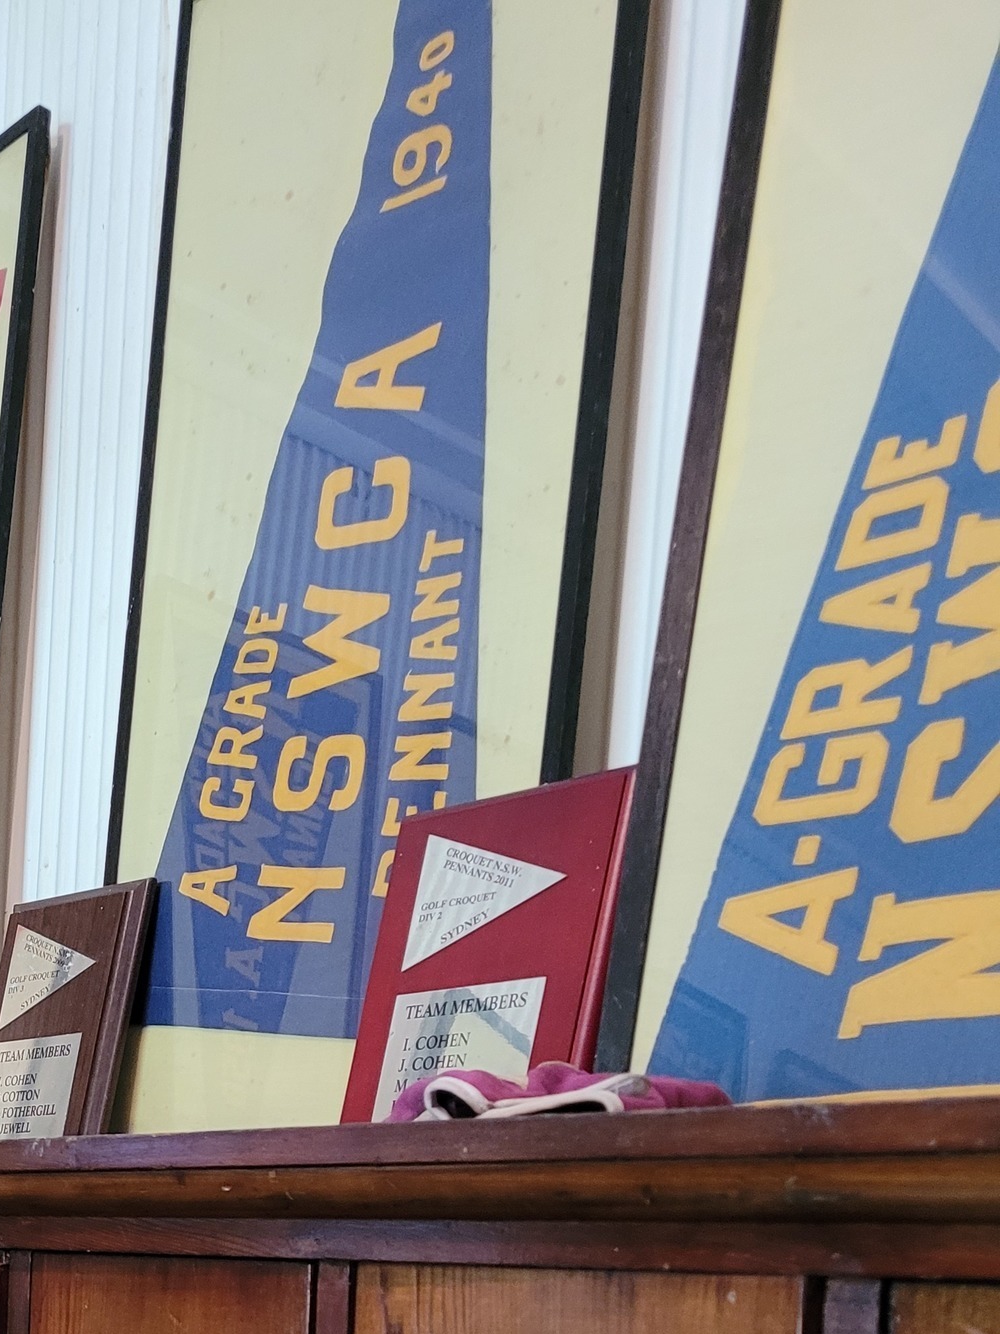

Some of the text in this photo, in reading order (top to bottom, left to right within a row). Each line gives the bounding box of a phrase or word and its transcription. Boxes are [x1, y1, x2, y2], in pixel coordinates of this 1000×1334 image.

[379, 30, 454, 213] 1940
[178, 603, 288, 916] A GRADE
[446, 847, 494, 868] CROQUET
[443, 859, 515, 888] PENNANTS 2011
[420, 891, 497, 912] GOLF CROQUET
[418, 913, 436, 923] DIV
[440, 908, 490, 945] SYDNEY
[23, 943, 53, 962] PENNANTS
[25, 934, 53, 952] CROQUET
[9, 970, 60, 985] GOLF CROQUET
[20, 983, 50, 1010] SYDNEY
[406, 991, 529, 1020] TEAM MEMBERS
[402, 1032, 471, 1052] I. COHEN
[0, 1043, 72, 1063] TEAM MEMBERS
[397, 1053, 467, 1073] J. COHEN
[4, 1073, 38, 1087] COHEN
[2, 1089, 40, 1103] COTTON
[1, 1104, 57, 1119] FOTHERGILL
[0, 1121, 31, 1135] JEWELL
